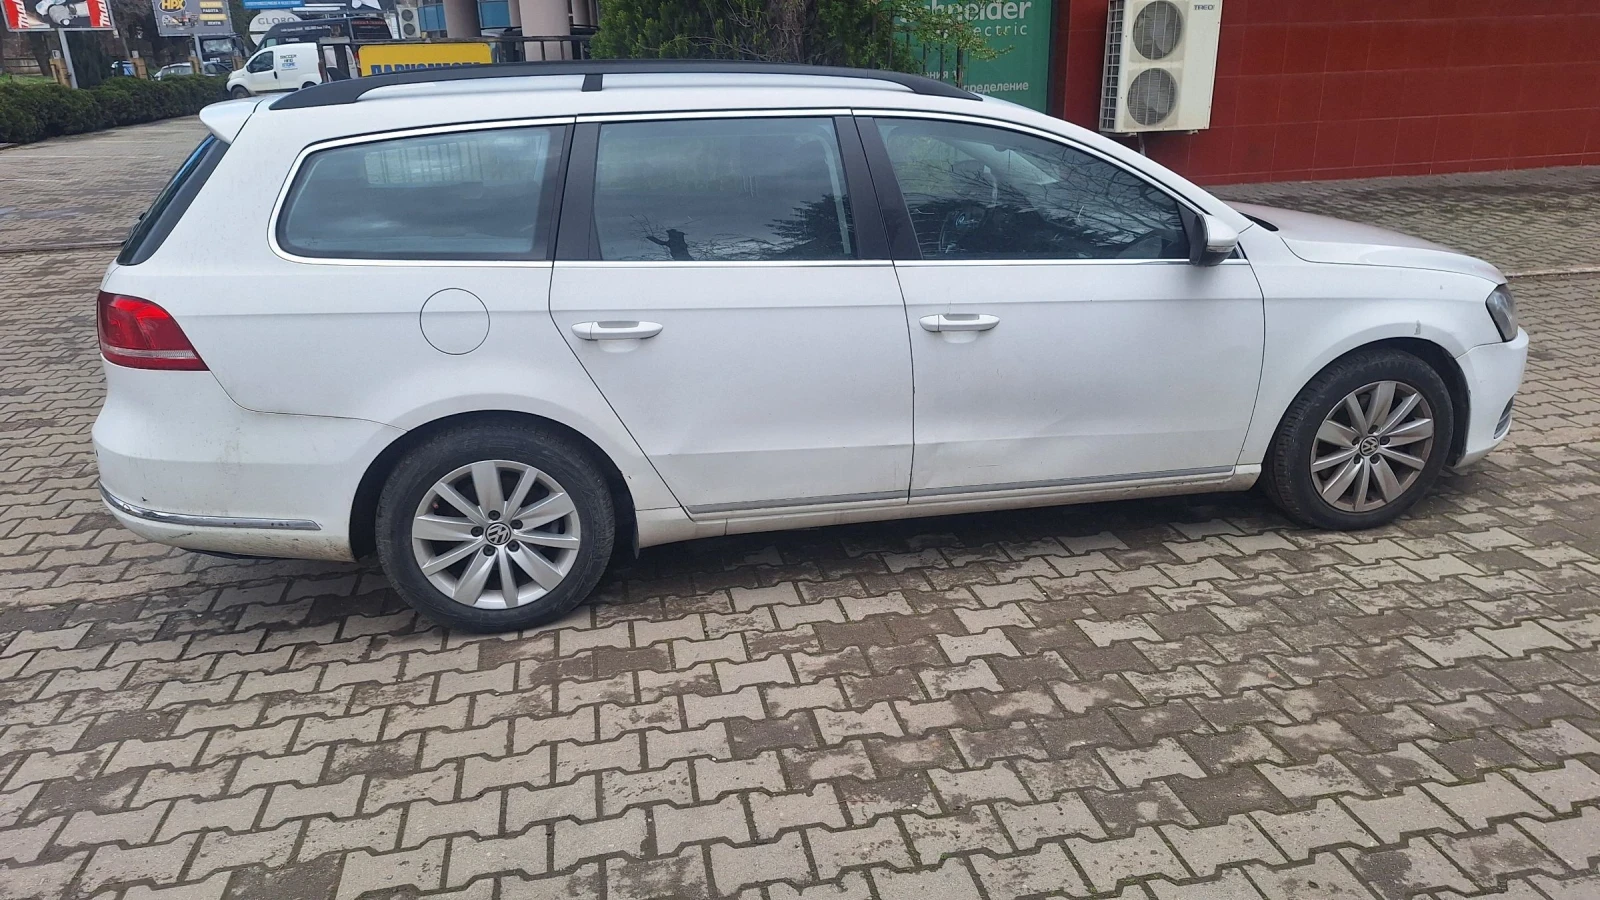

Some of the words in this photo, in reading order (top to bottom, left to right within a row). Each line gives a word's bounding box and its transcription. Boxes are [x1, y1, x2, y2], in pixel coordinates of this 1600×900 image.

[161, 0, 184, 10] HPX
[973, 21, 1028, 37] ectric
[963, 82, 1029, 94] пределение
